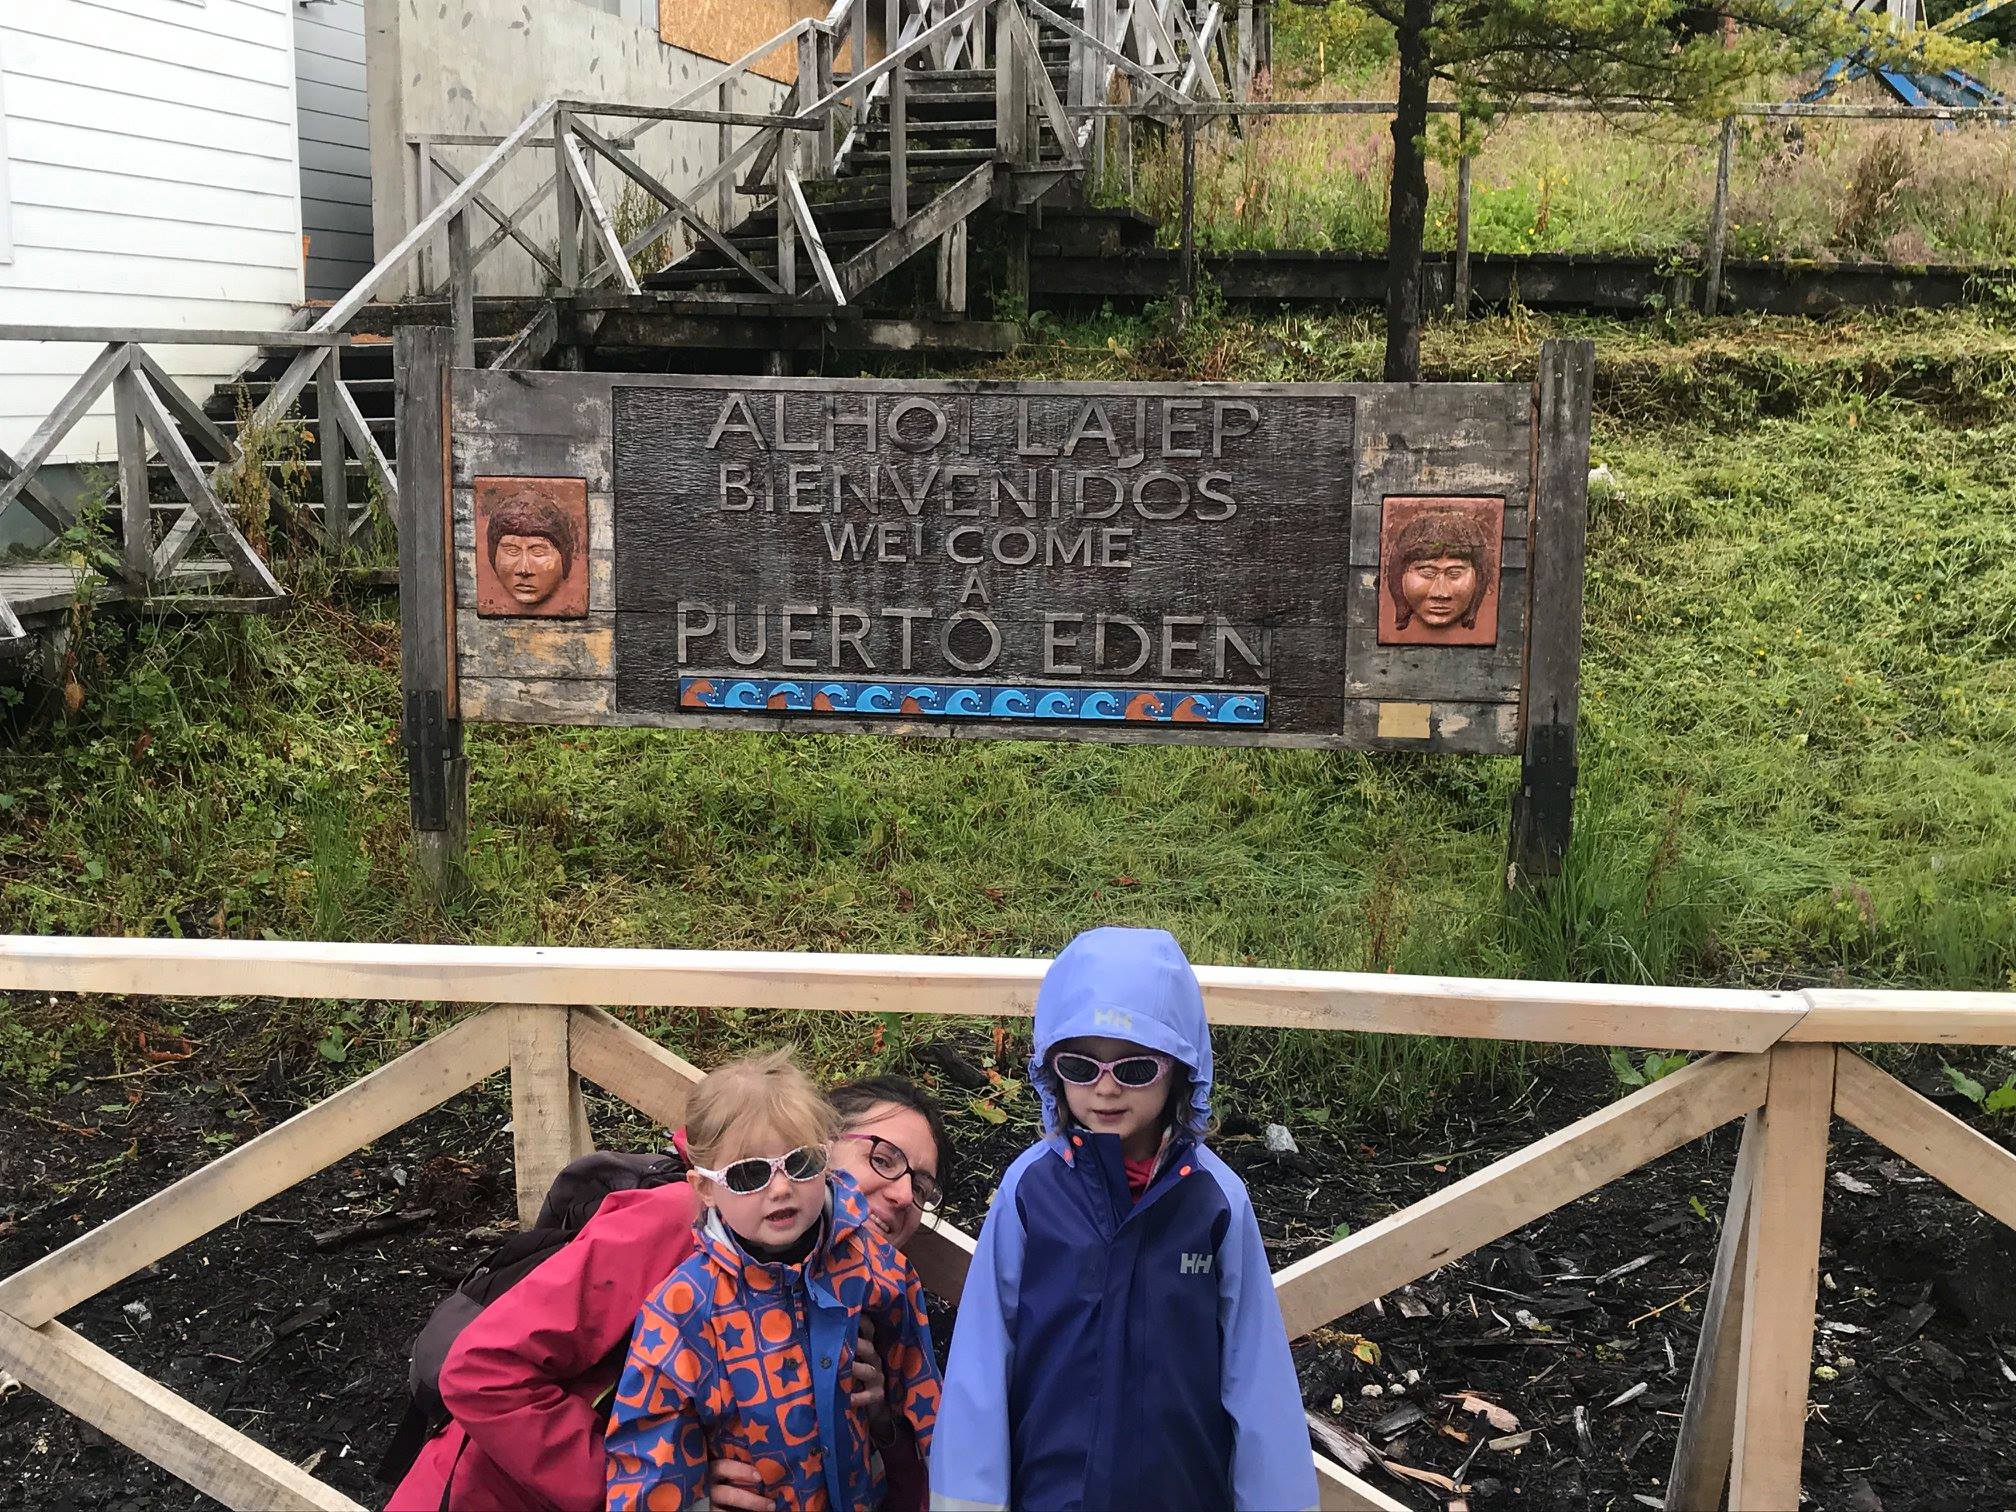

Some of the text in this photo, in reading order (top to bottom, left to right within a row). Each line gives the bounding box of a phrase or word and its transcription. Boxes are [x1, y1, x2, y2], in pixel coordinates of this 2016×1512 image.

[705, 392, 1260, 470] ALHOI LAJEP
[718, 463, 1238, 522] BIENVENIDOS
[960, 567, 991, 604] A
[676, 600, 1272, 680] PUERTO EDEN
[1180, 1252, 1214, 1275] HH
